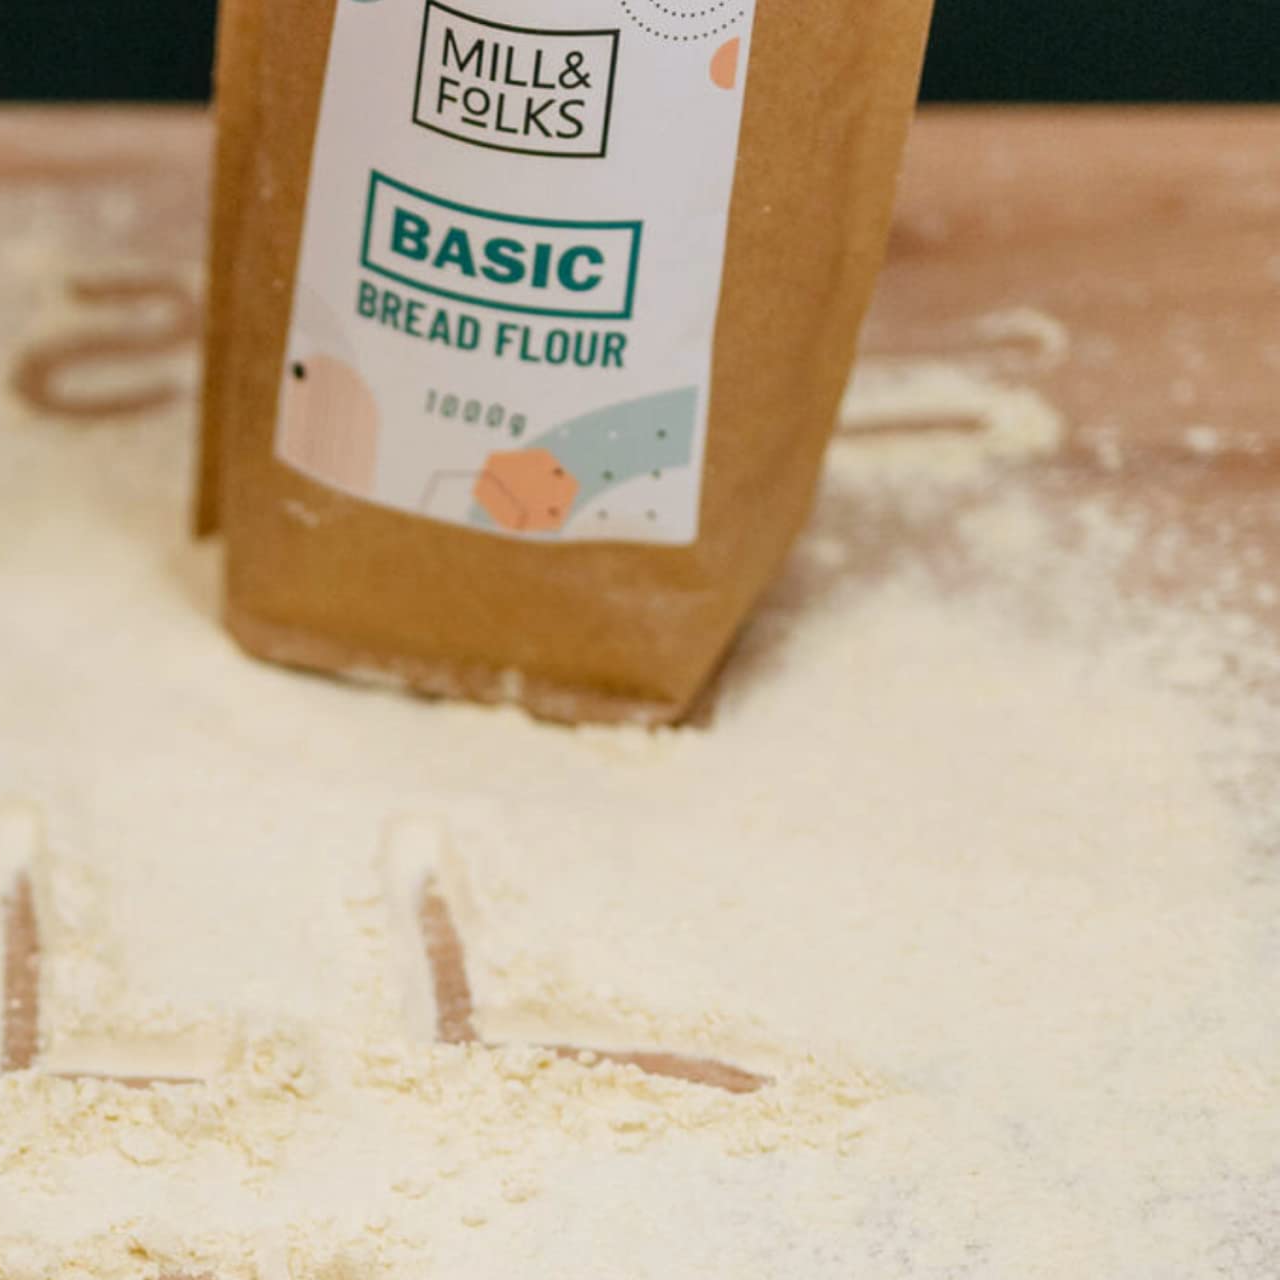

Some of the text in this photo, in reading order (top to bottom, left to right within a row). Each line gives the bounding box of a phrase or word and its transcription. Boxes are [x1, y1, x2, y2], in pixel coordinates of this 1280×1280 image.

[390, 205, 606, 293] BASIC
[356, 280, 629, 369] BREAD FLOUR
